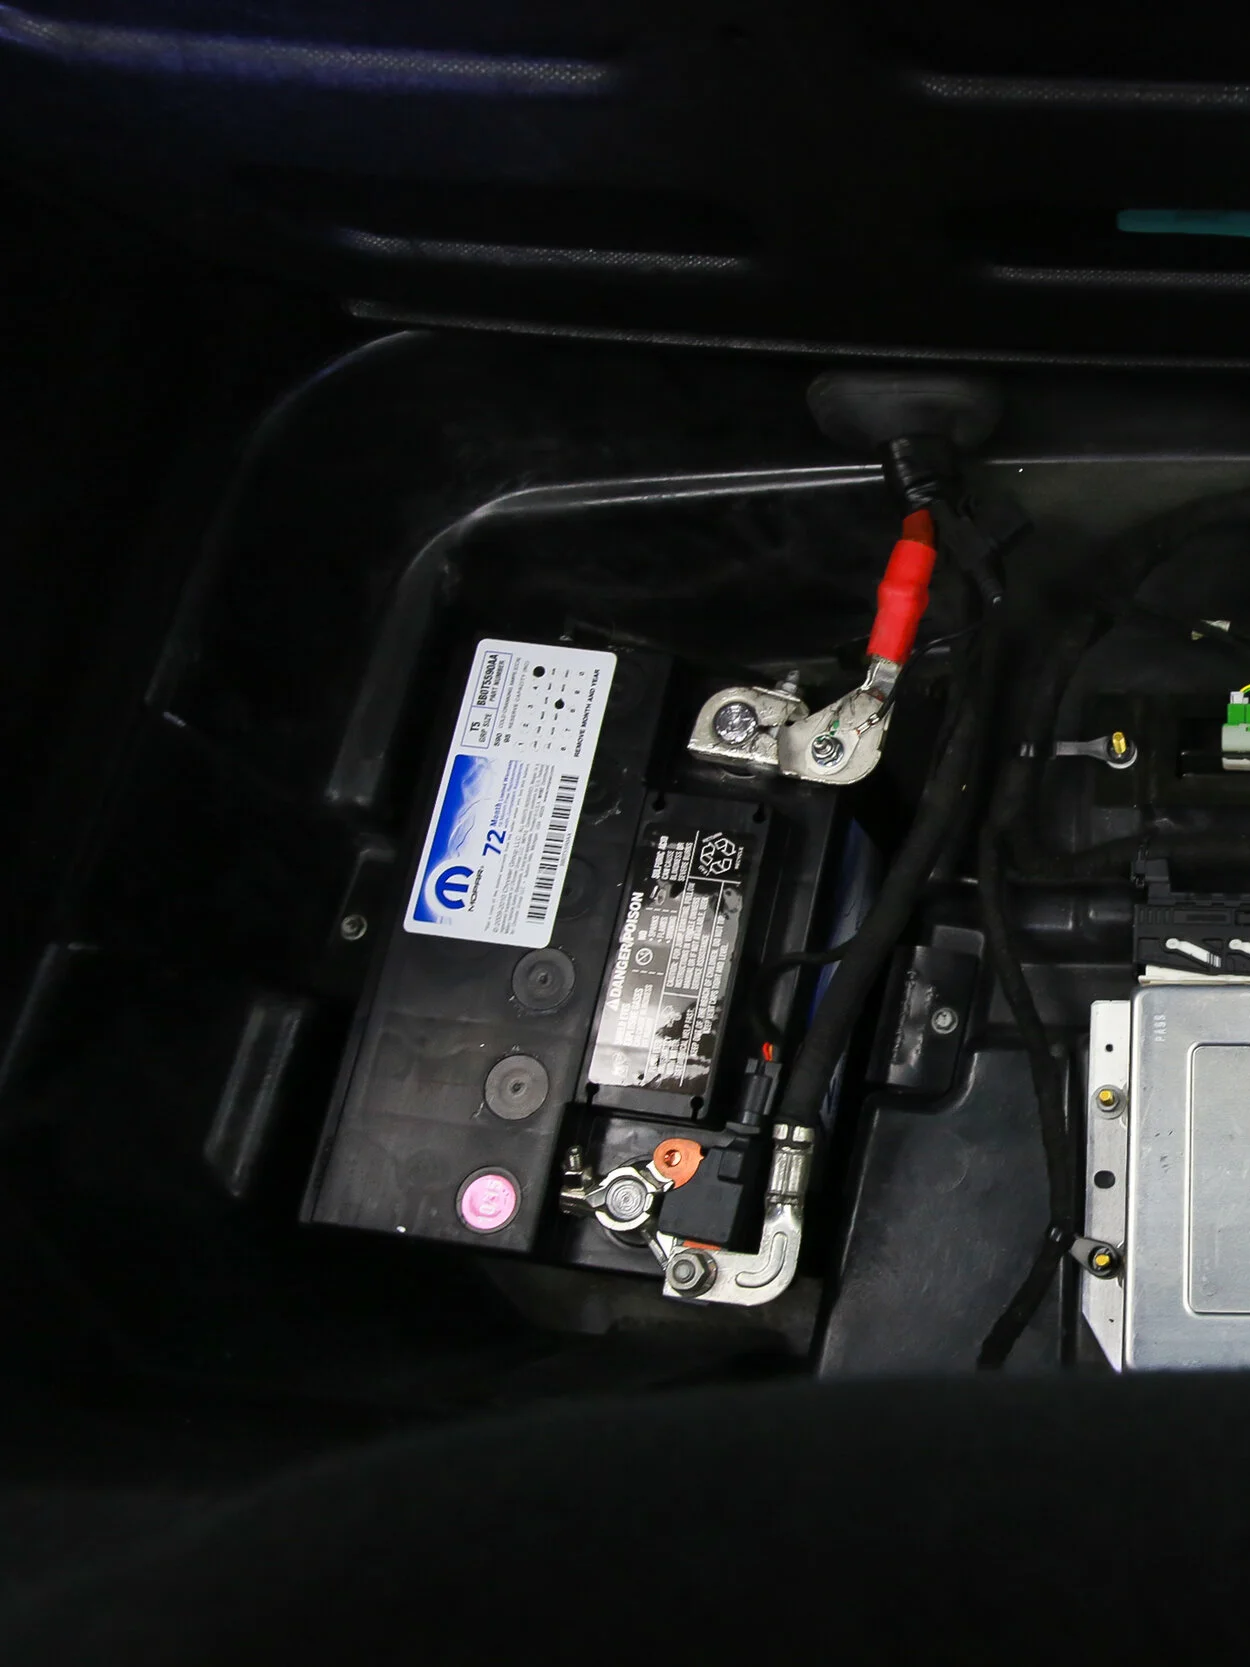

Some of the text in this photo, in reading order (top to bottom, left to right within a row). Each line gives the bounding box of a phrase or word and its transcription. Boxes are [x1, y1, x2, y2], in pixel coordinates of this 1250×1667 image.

[489, 660, 505, 701] PART NUMBER
[469, 721, 480, 731] T5
[574, 668, 600, 757] REMOVE MONTH AND YEAR
[490, 802, 502, 827] Month
[481, 828, 506, 857] 72
[467, 868, 484, 912] MOPAR
[610, 891, 644, 999] DANGER/POISON
[1153, 1014, 1168, 1042] PASS
